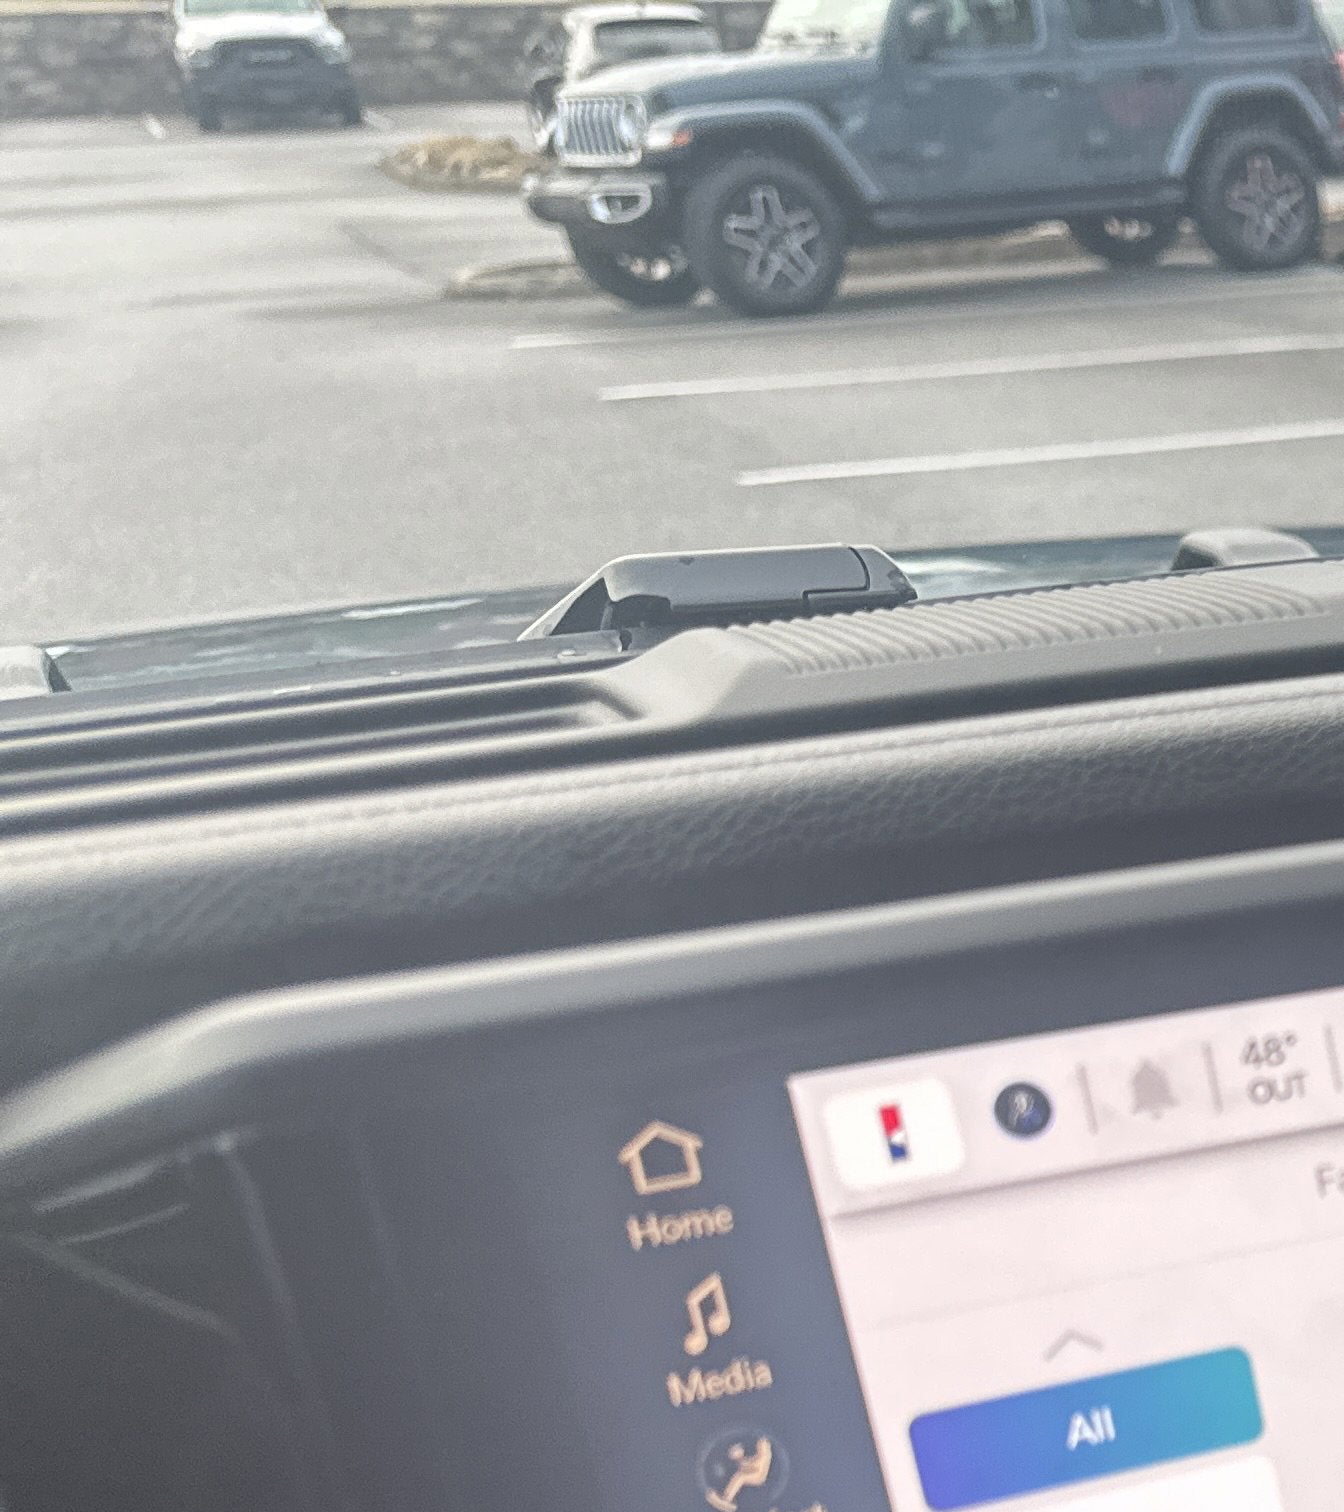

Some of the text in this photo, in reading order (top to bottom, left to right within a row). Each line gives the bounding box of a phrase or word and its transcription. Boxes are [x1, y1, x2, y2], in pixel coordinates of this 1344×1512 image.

[1248, 1070, 1308, 1106] OUT
[626, 1204, 734, 1252] Home
[666, 1356, 774, 1408] Media
[1066, 1406, 1116, 1452] All
